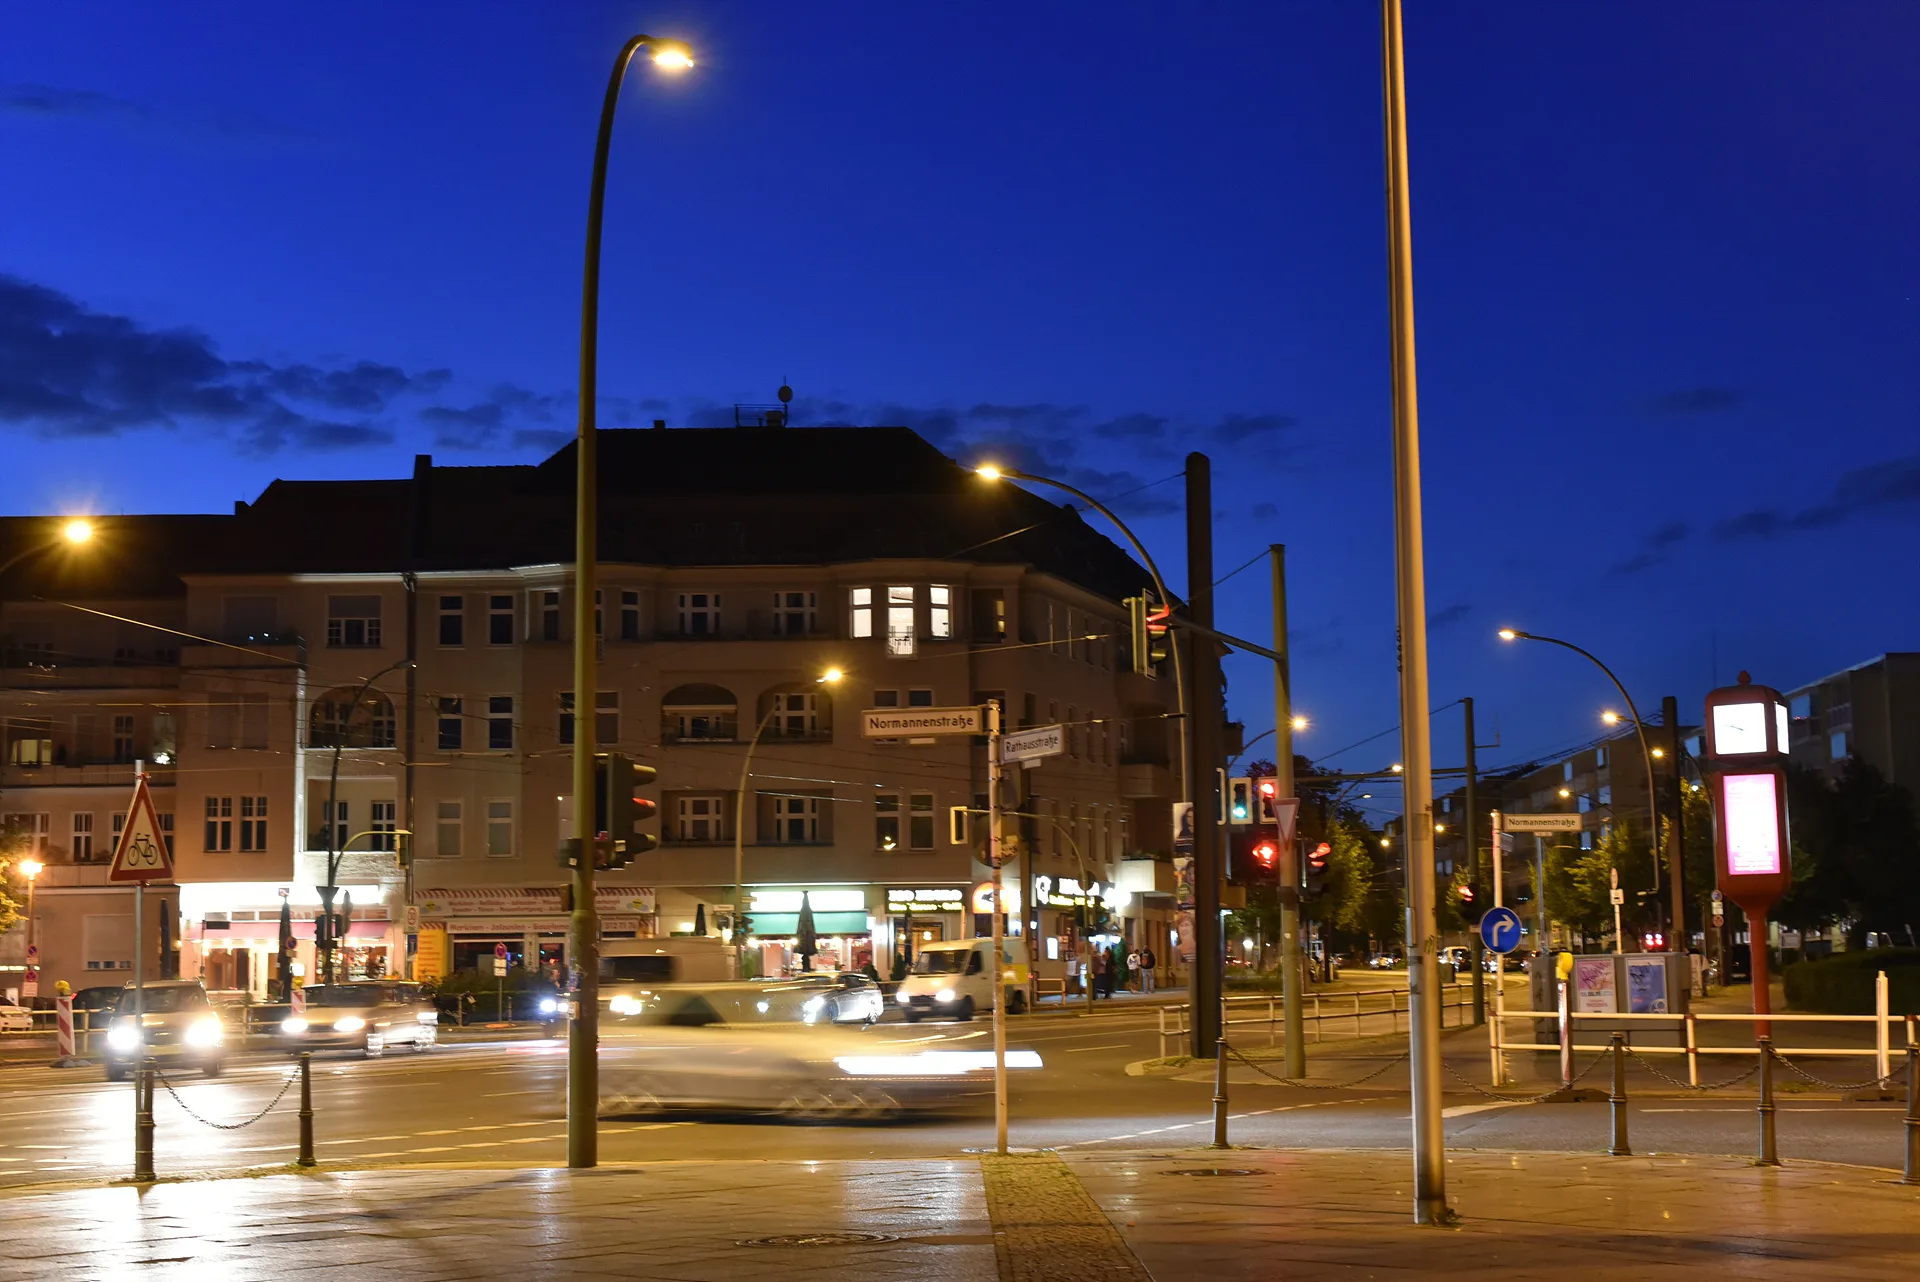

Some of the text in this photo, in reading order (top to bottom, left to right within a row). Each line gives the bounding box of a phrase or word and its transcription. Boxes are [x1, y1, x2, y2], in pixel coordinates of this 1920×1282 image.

[869, 715, 974, 730] Normannenstraße
[1005, 734, 1059, 754] Rathausstraße
[1508, 818, 1576, 828] Normannenstraße
